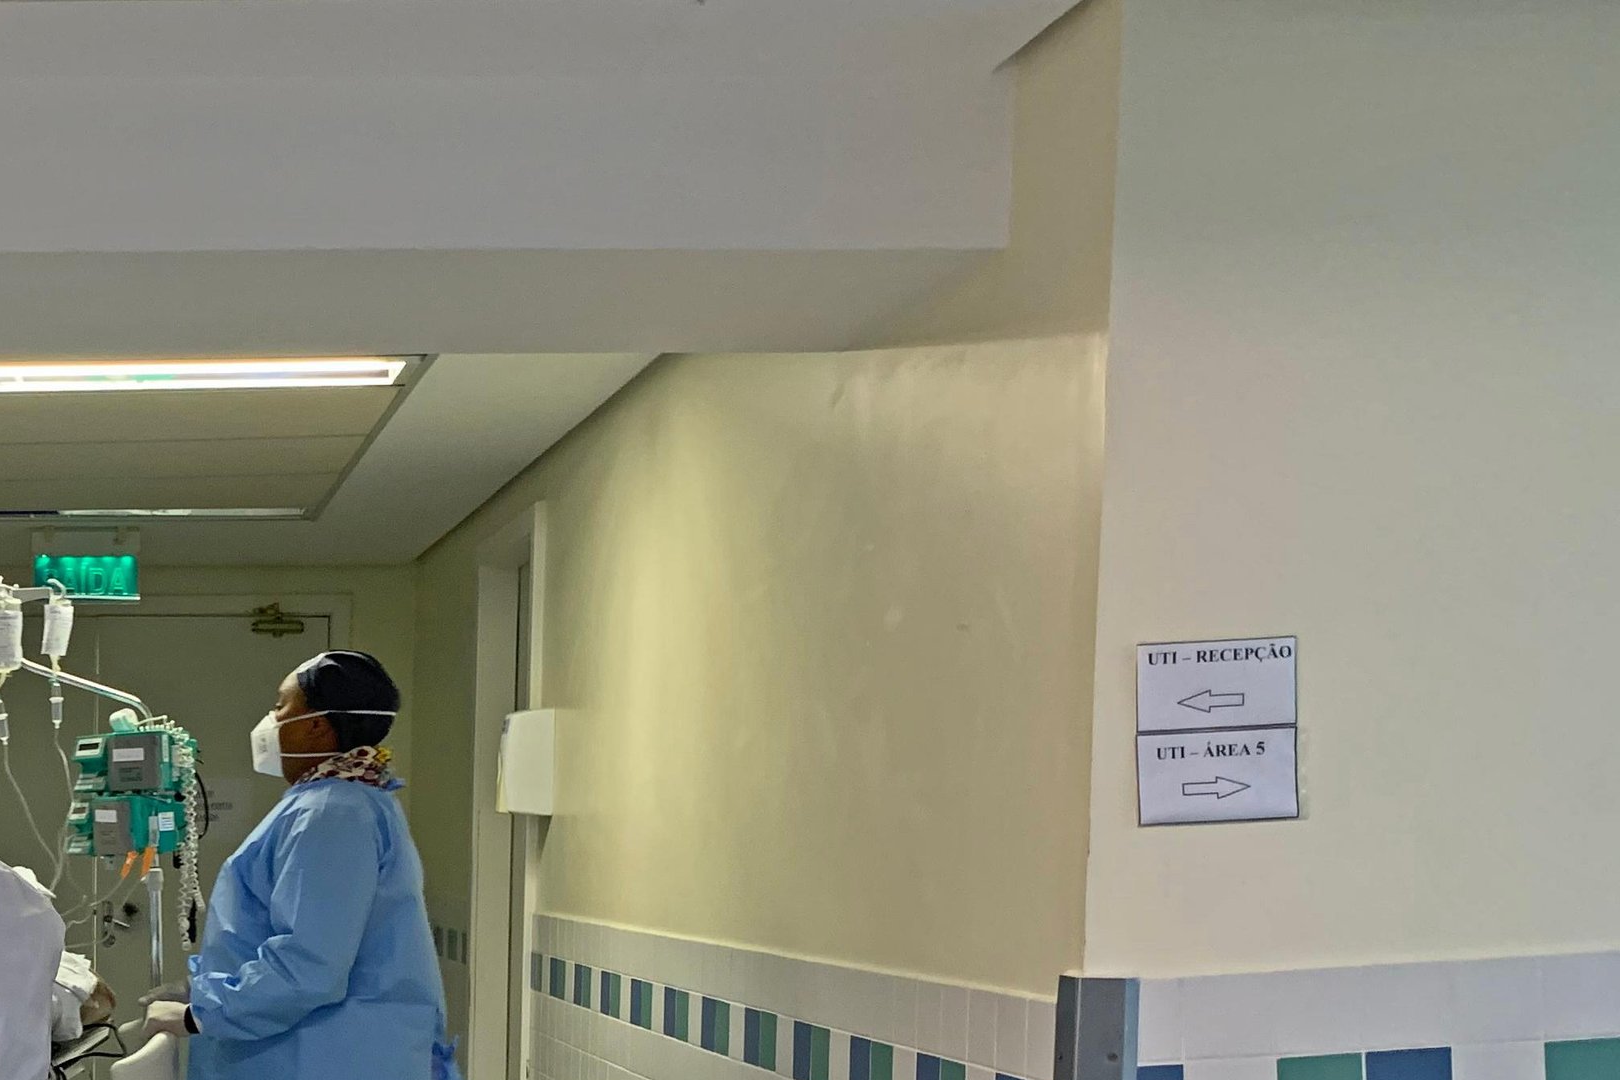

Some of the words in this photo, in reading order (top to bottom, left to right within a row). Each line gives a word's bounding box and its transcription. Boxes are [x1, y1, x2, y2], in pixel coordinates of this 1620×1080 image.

[1147, 651, 1177, 666] UTI
[1196, 643, 1292, 664] RECEPÇÃO
[1156, 746, 1185, 760] UTI
[1203, 741, 1251, 758] ÁREA
[1256, 741, 1265, 756] 5
